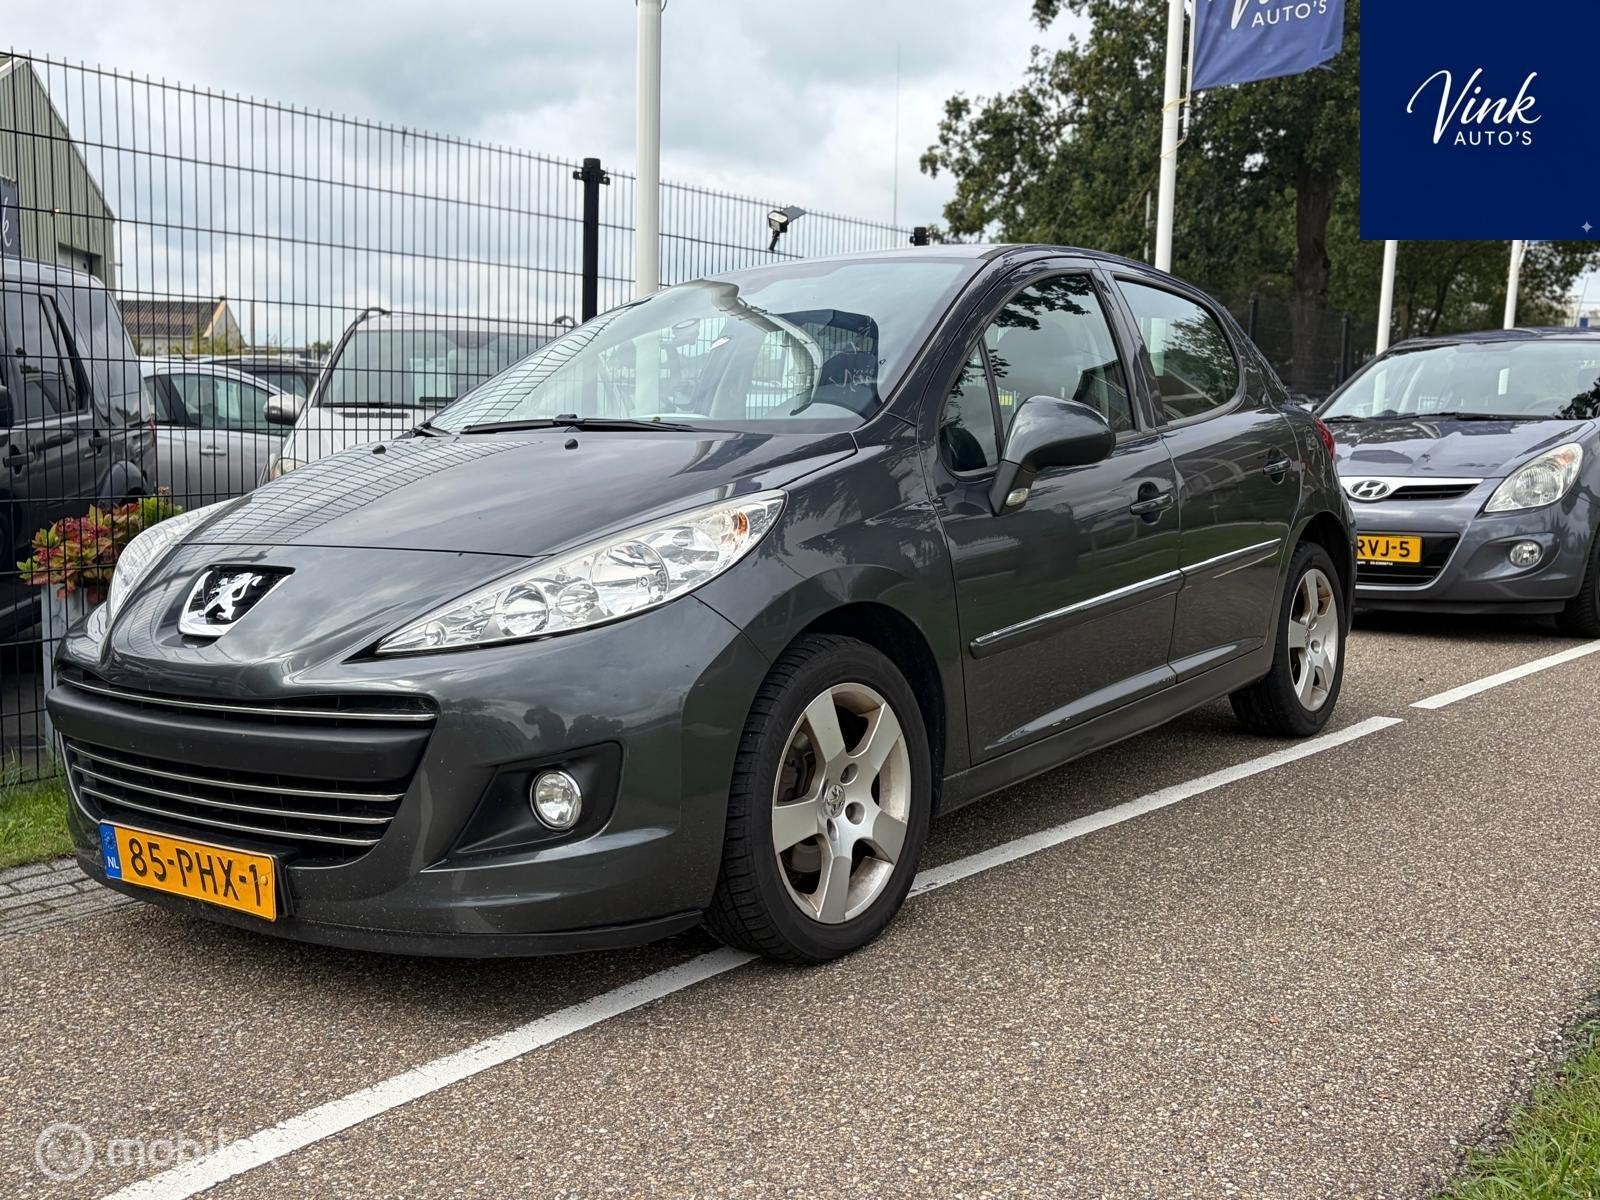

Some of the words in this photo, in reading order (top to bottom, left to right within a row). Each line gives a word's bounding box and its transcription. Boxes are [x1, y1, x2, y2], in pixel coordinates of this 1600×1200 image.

[1251, 0, 1328, 28] AUTO'S
[106, 856, 120, 869] NL
[127, 837, 262, 907] 85-PHX-1
